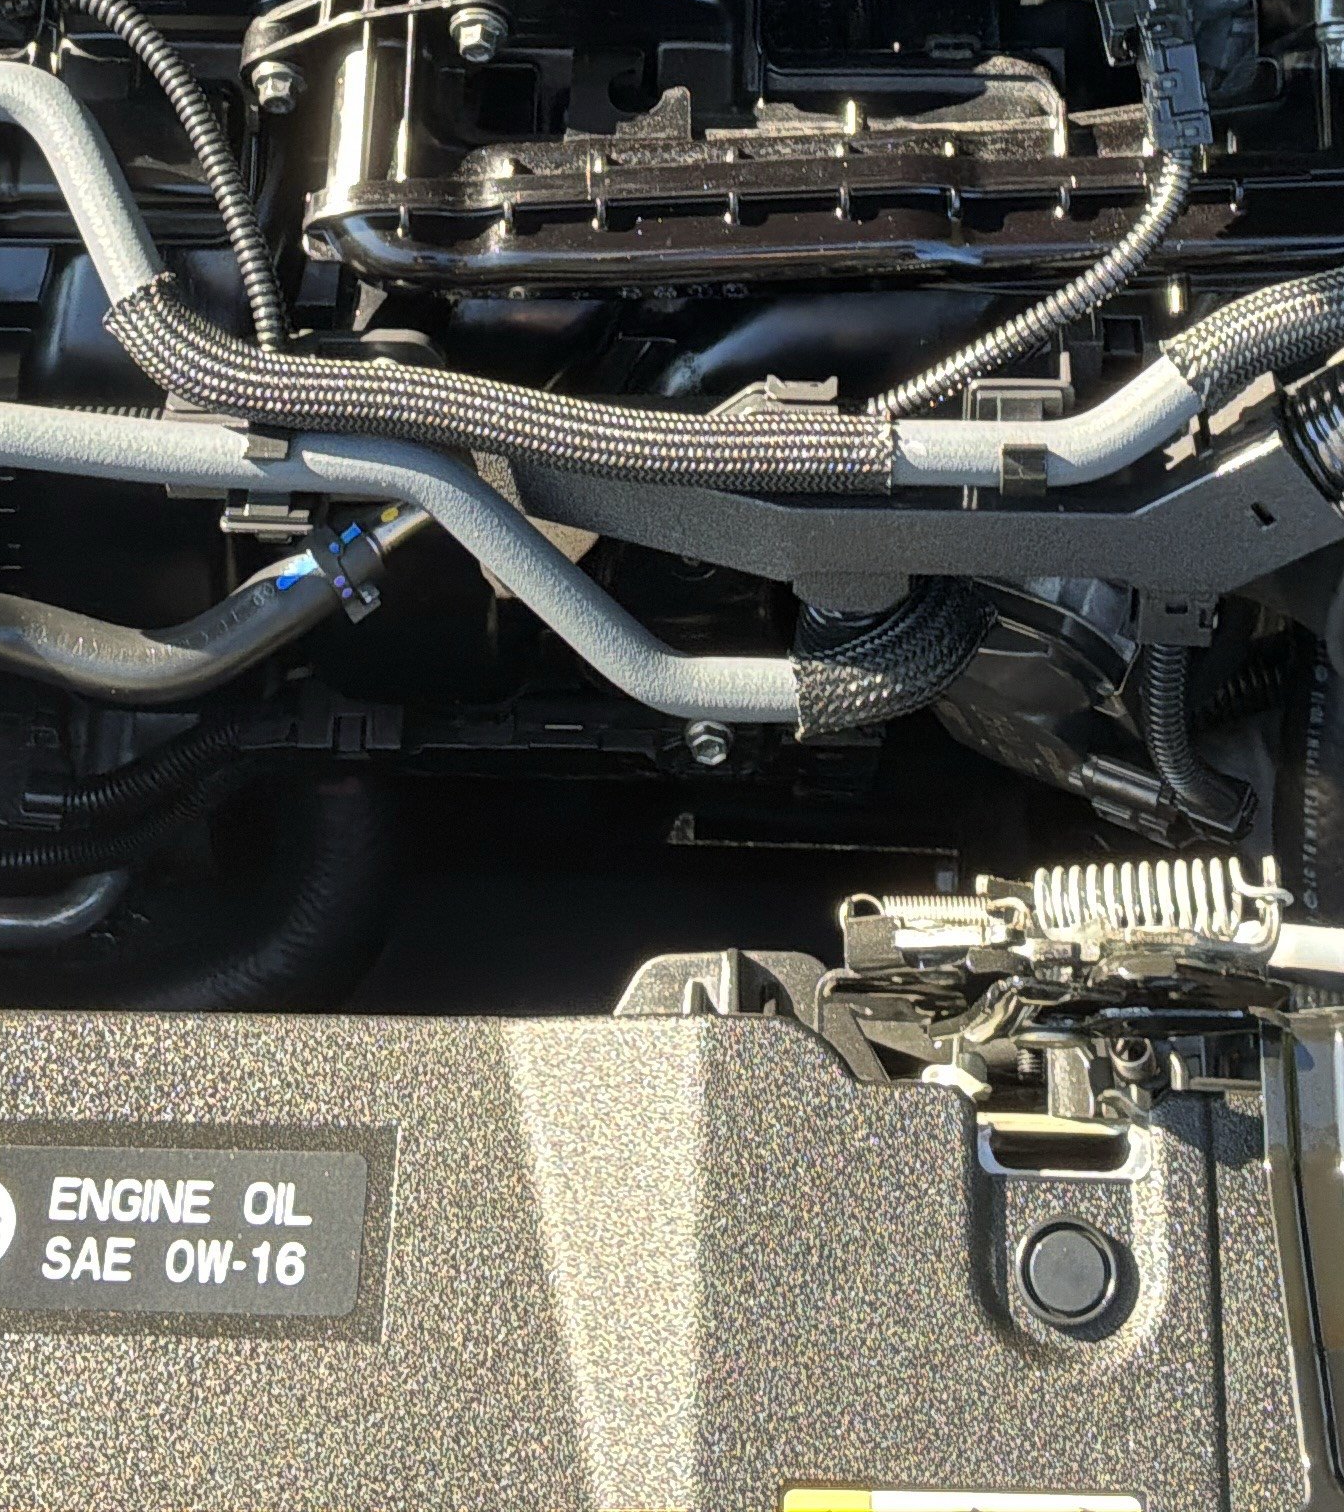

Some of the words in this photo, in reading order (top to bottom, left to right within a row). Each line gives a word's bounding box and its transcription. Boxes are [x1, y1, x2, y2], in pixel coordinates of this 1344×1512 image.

[48, 1176, 215, 1224] ENGINE
[243, 1181, 313, 1226] OIL
[41, 1235, 136, 1281] SAE
[165, 1239, 307, 1286] 0W-16
